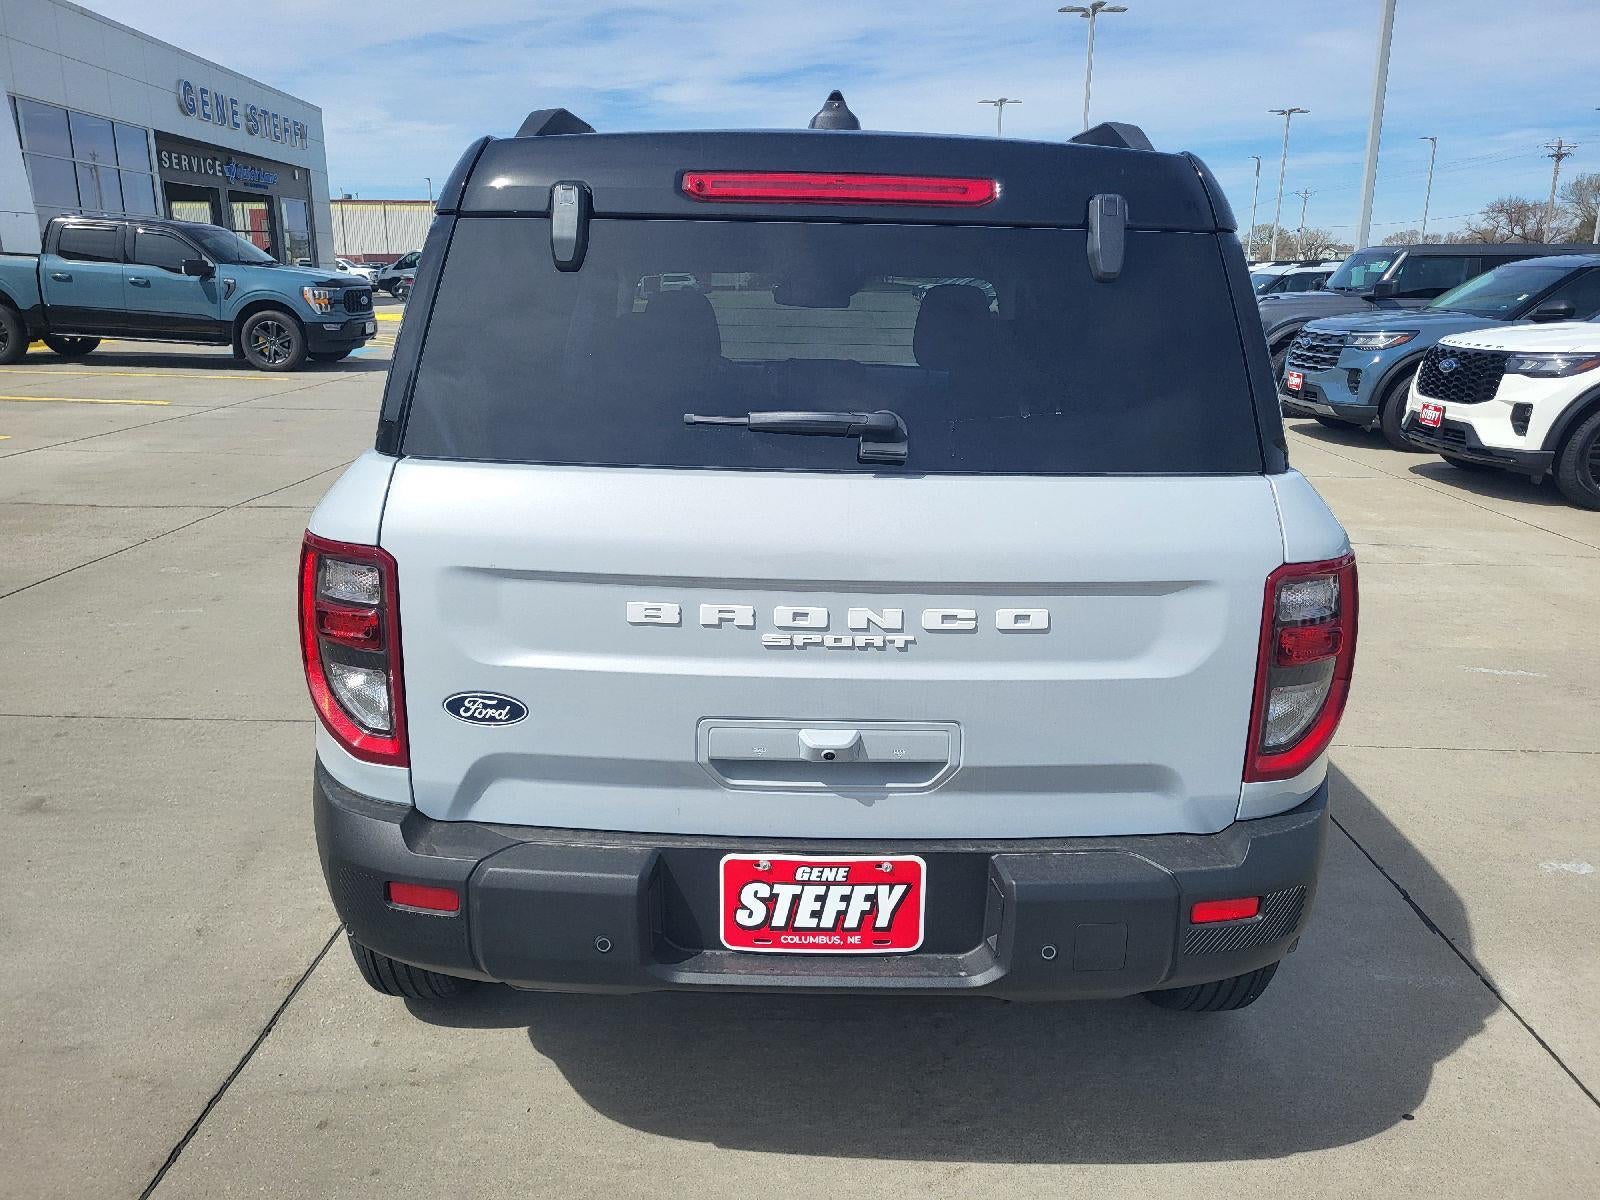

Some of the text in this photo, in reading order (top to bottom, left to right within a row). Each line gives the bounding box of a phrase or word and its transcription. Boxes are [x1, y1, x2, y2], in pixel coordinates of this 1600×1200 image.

[178, 79, 308, 150] GENE STEFFY
[161, 150, 223, 177] SERVICE
[626, 601, 1051, 632] BRONCO
[761, 633, 916, 649] SPORT
[459, 697, 511, 720] Ford
[795, 866, 850, 882] GENE
[735, 882, 911, 930] STEFFY
[780, 935, 862, 945] COLUMBUS, NE
